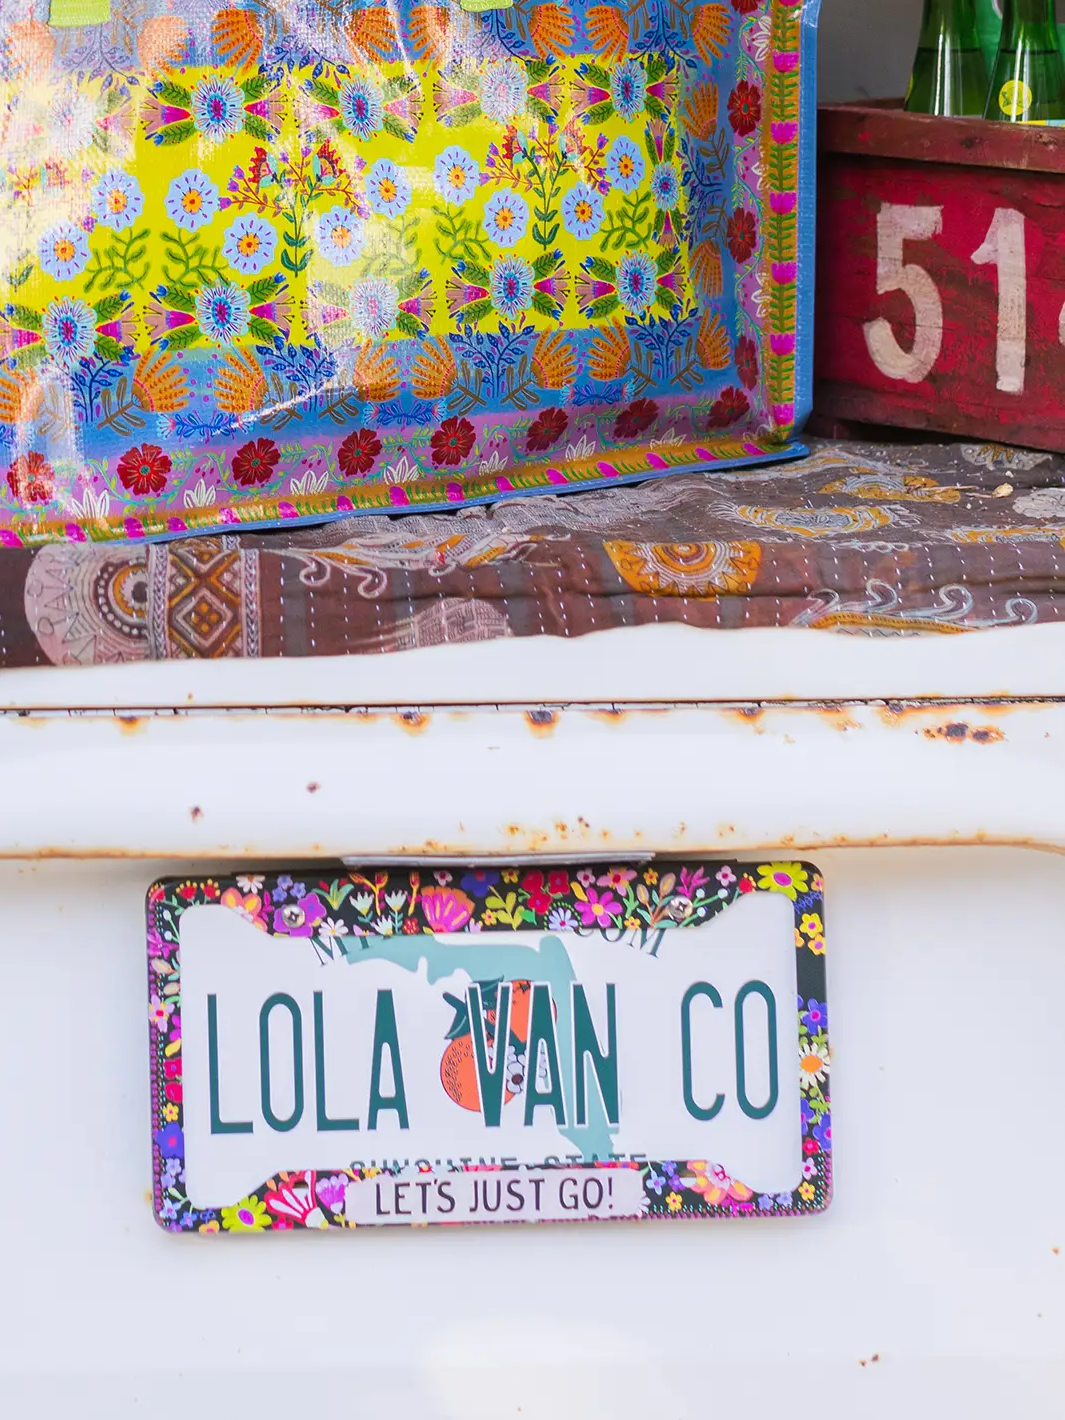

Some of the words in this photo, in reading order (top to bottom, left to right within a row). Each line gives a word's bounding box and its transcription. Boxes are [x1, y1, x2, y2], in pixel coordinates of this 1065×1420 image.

[862, 201, 1065, 395] 51
[207, 989, 410, 1134] LOLA
[466, 982, 619, 1127] VAN
[681, 980, 779, 1121] CO
[375, 1179, 456, 1216] LET'S
[469, 1177, 545, 1213] JUST
[559, 1176, 614, 1210] GO!
